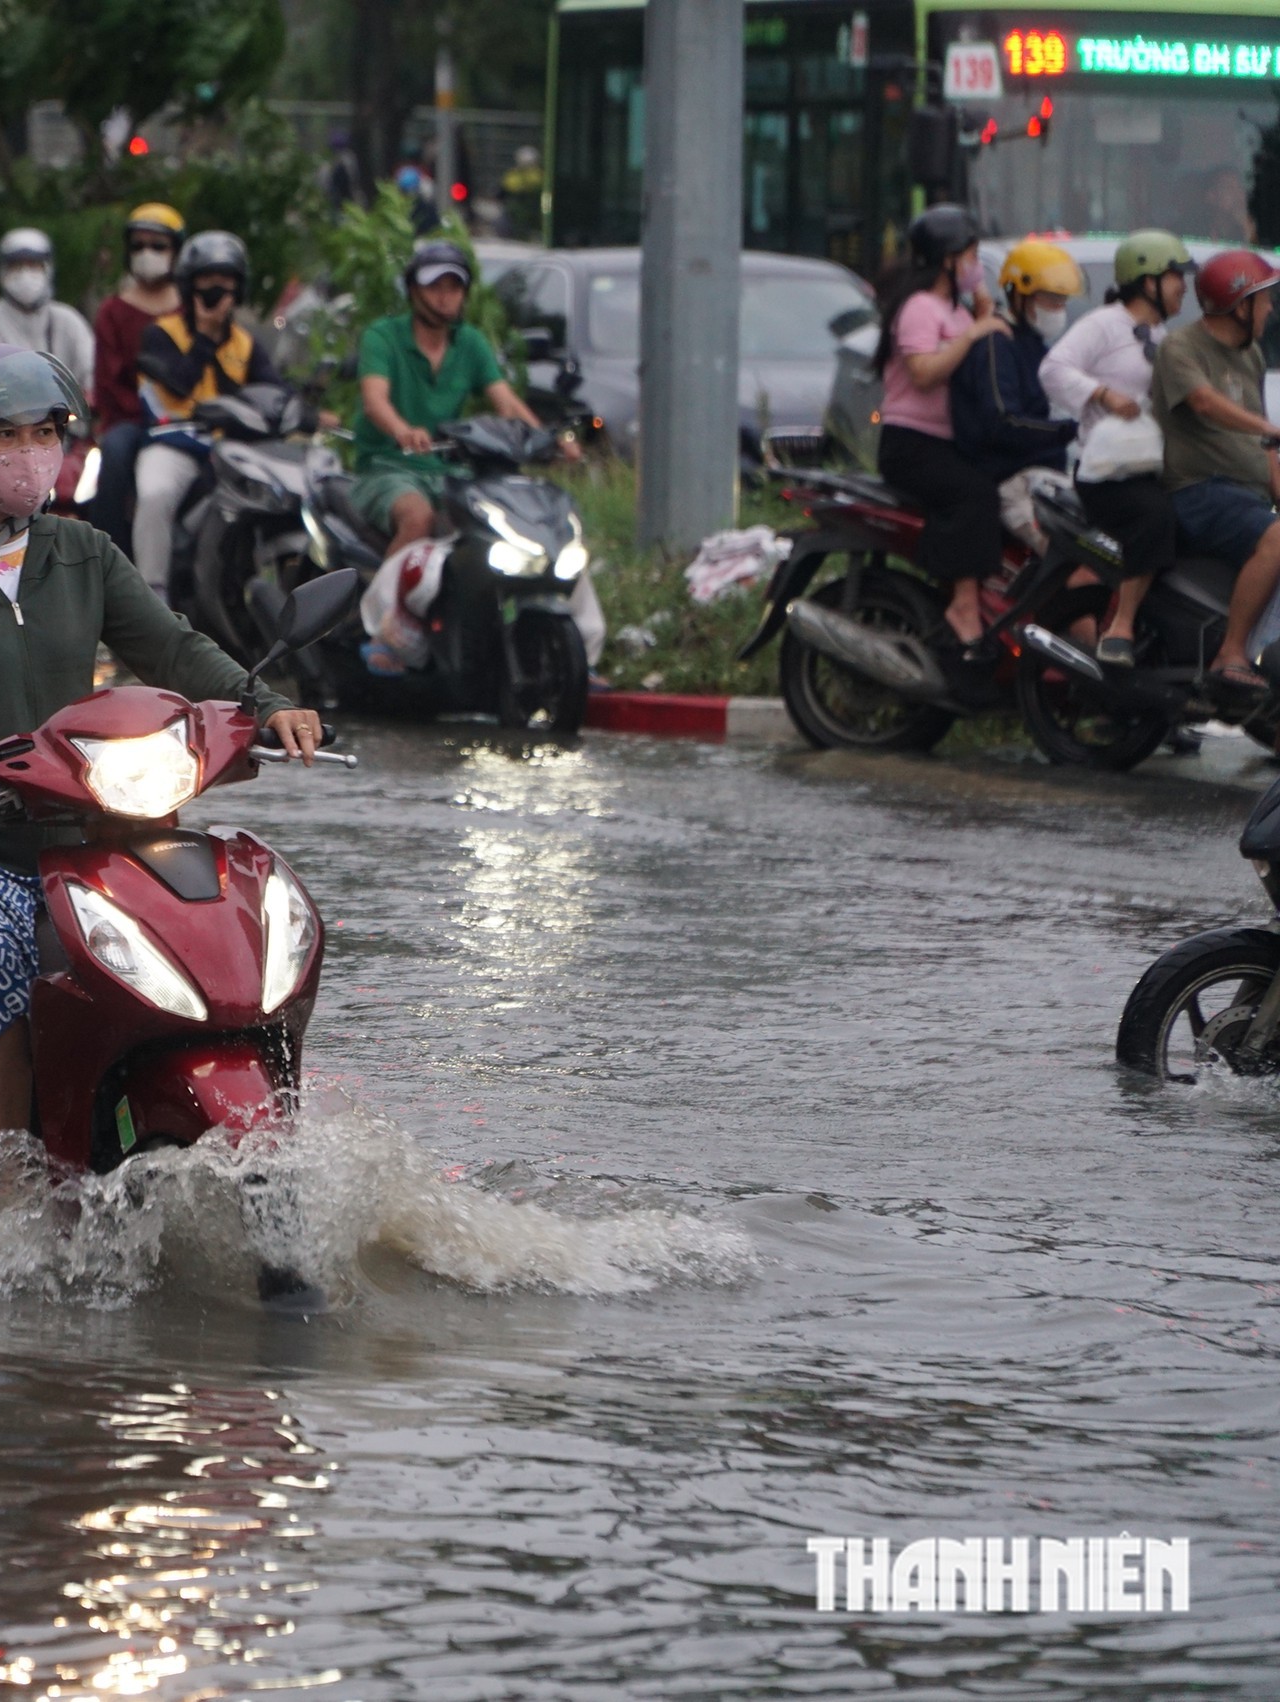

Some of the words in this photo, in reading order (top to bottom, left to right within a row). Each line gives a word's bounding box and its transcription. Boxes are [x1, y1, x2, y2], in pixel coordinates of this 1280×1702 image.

[1005, 29, 1066, 75] 139
[952, 56, 994, 91] 139
[153, 841, 200, 853] HONDA
